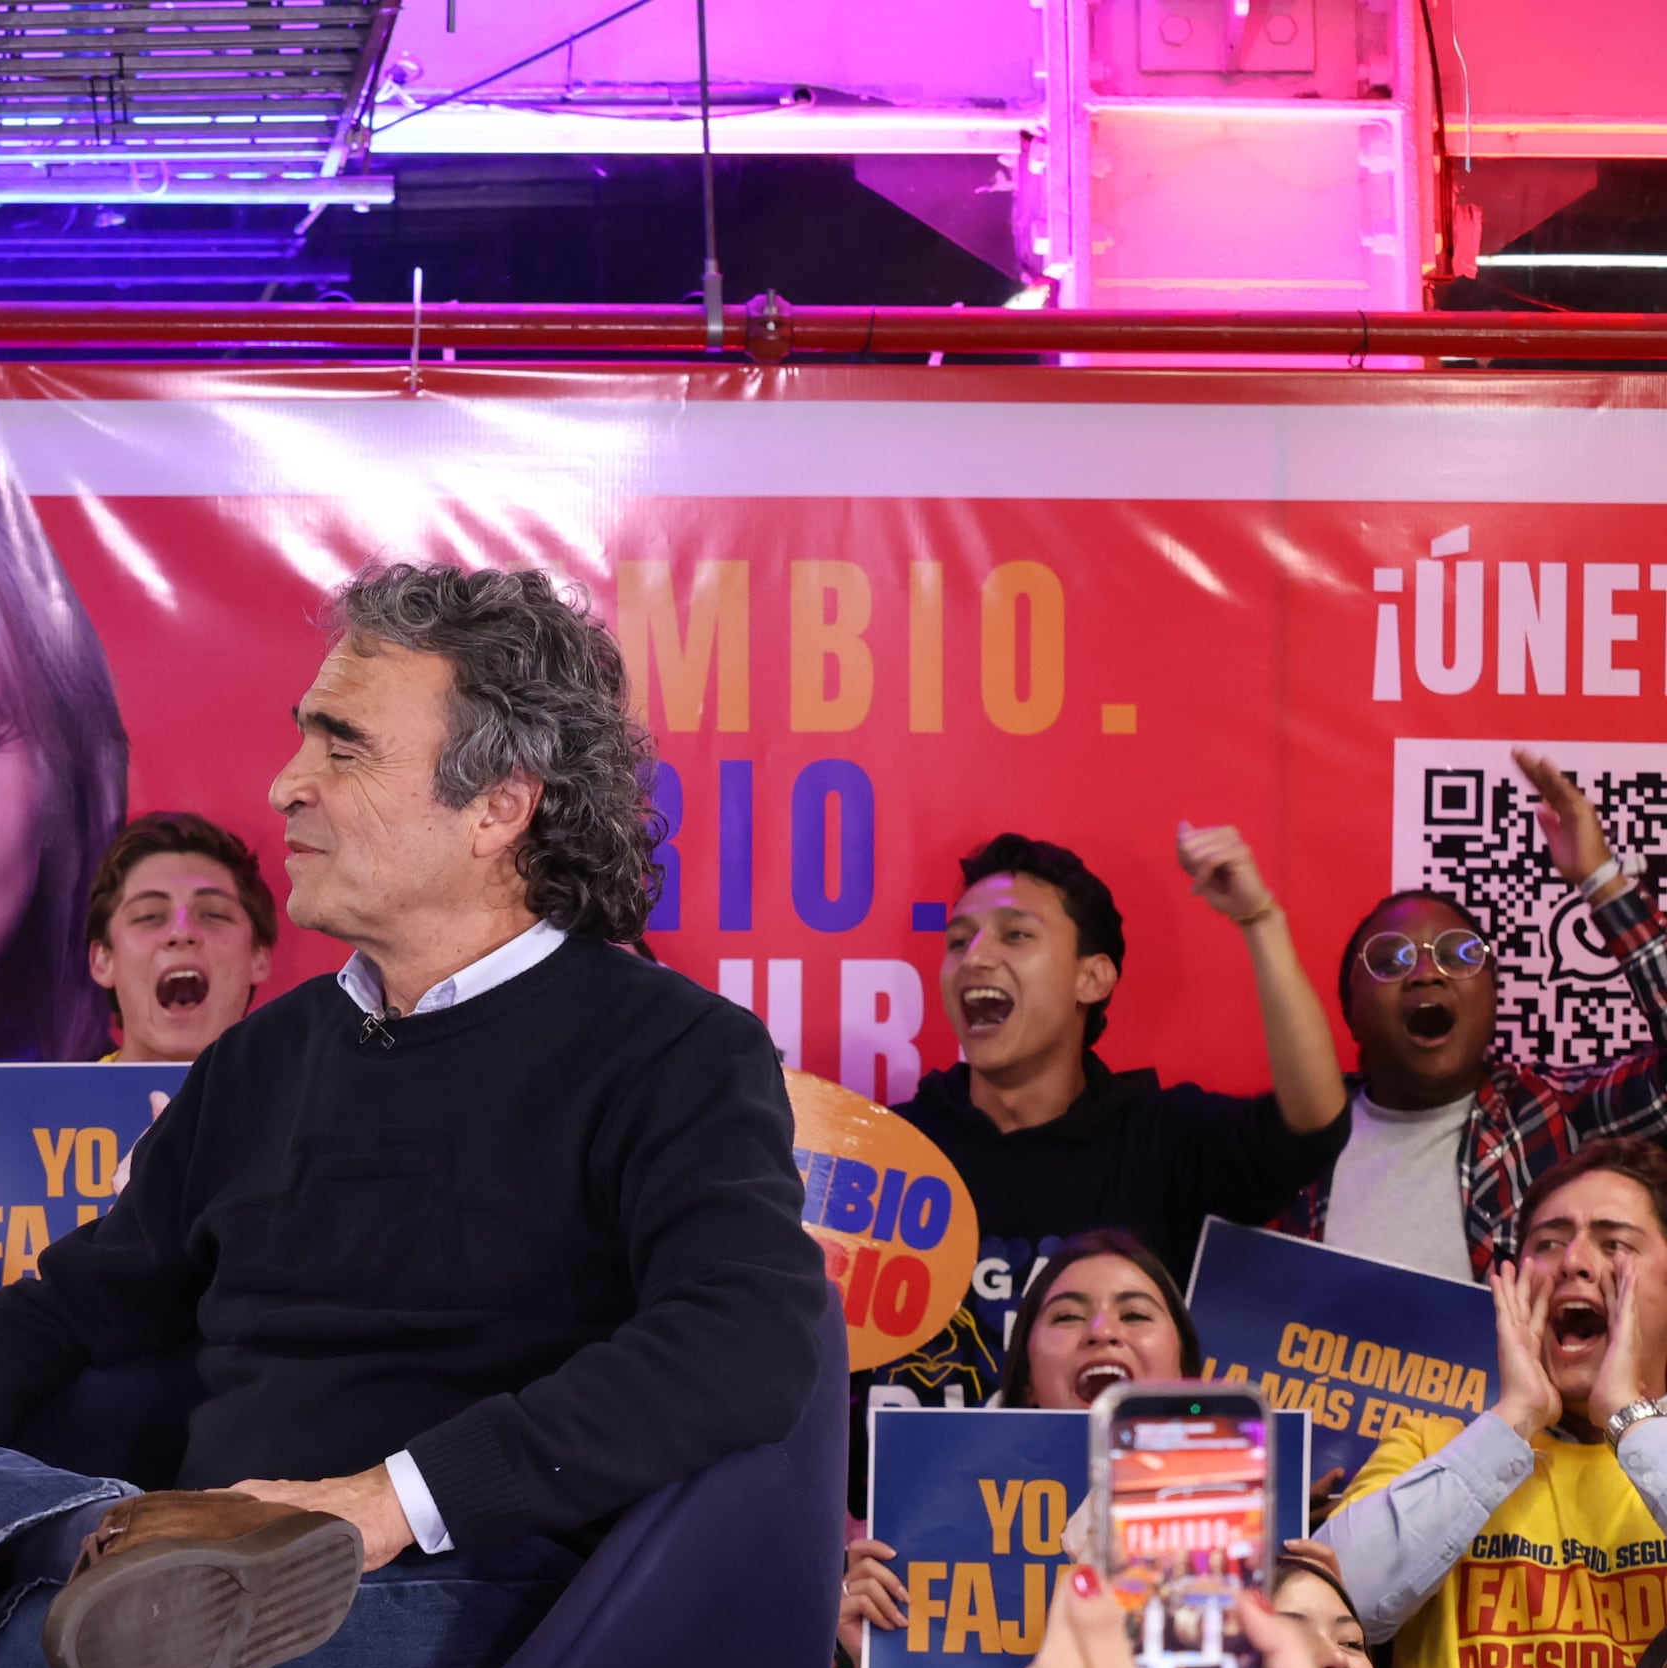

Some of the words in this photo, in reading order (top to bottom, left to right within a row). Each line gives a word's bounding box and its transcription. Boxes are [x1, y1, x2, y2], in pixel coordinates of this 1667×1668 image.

[618, 559, 1137, 736] MBIO.
[1373, 524, 1667, 702] ¡ÚNE
[32, 1127, 119, 1199] YO
[1259, 1371, 1355, 1432] MÁS
[1276, 1321, 1488, 1414] COLOMBIA
[978, 1478, 1068, 1556] YO
[1471, 1533, 1558, 1567] CAMBIO.
[1560, 1538, 1612, 1575] SERIO.
[906, 1560, 1077, 1656] FAJ
[1467, 1565, 1667, 1643] FAJARD
